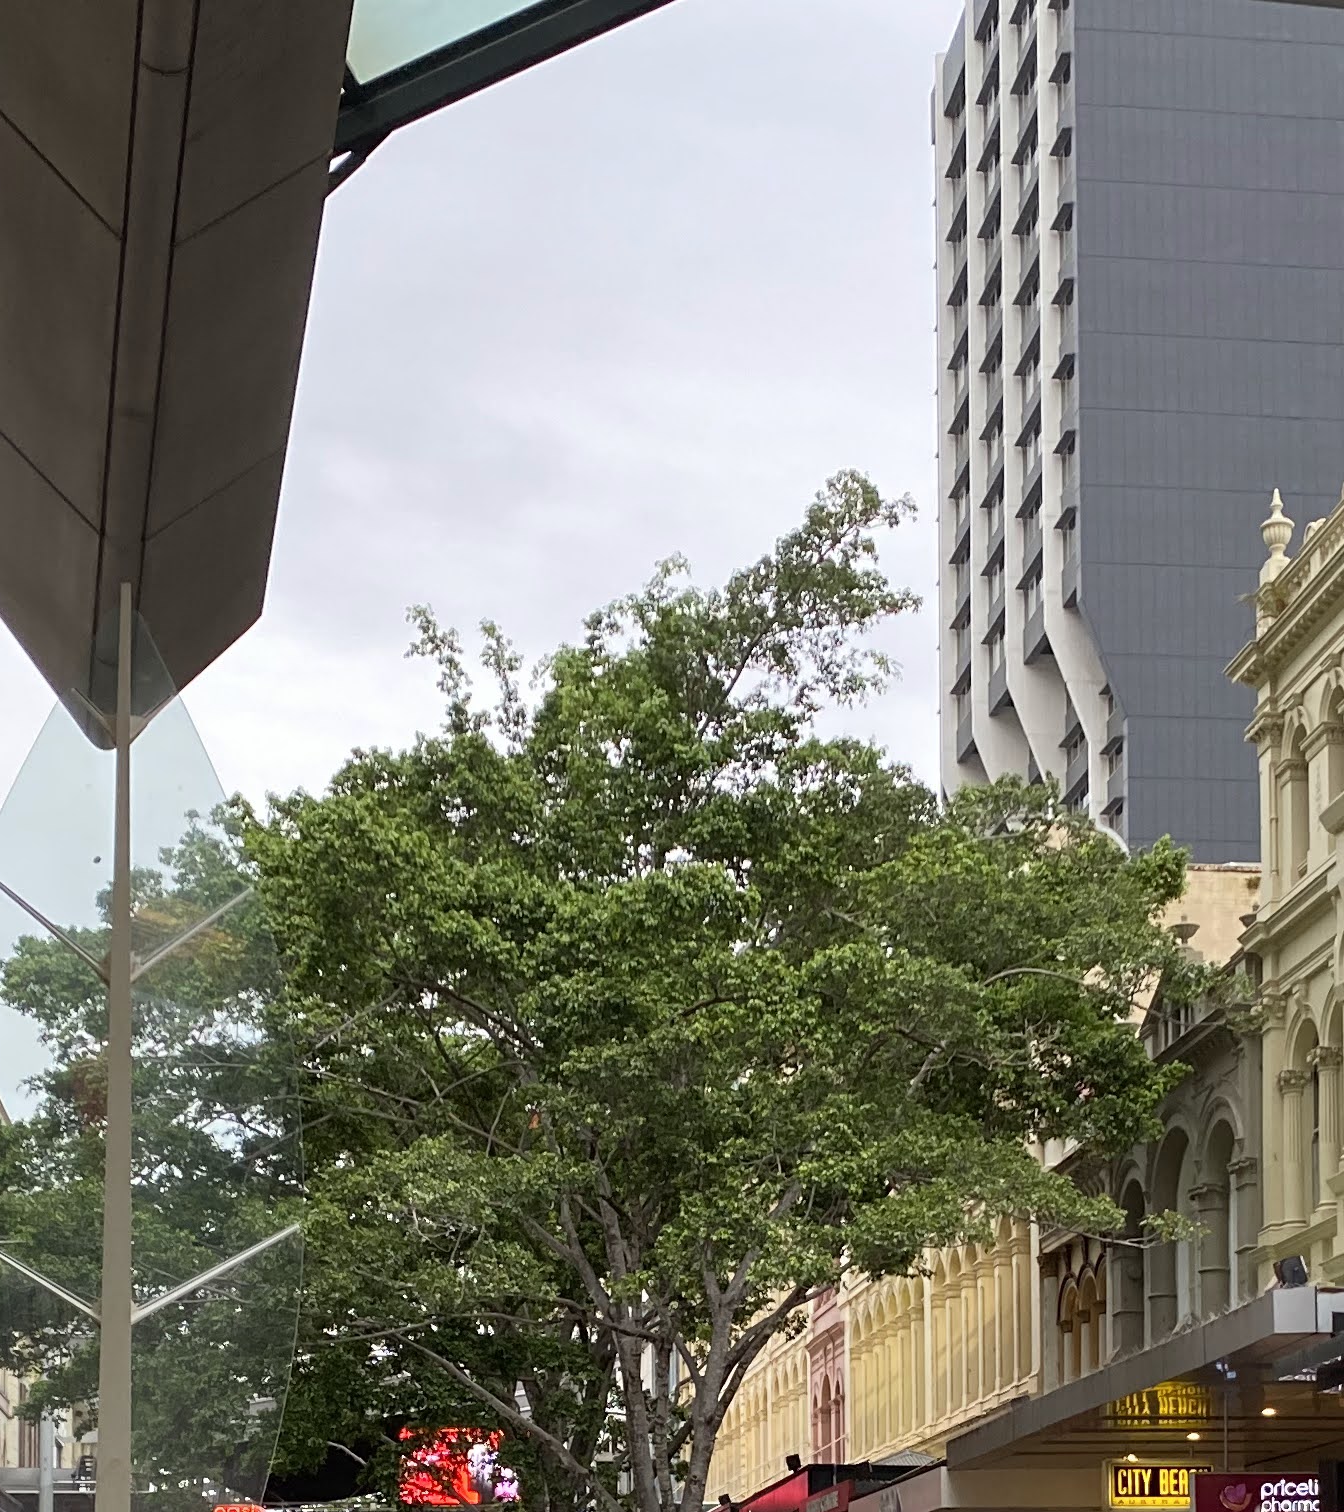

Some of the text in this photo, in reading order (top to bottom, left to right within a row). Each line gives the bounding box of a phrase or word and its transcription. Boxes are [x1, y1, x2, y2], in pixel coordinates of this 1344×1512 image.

[1117, 1468, 1205, 1496] CITY BEA
[1260, 1478, 1319, 1500] priceli
